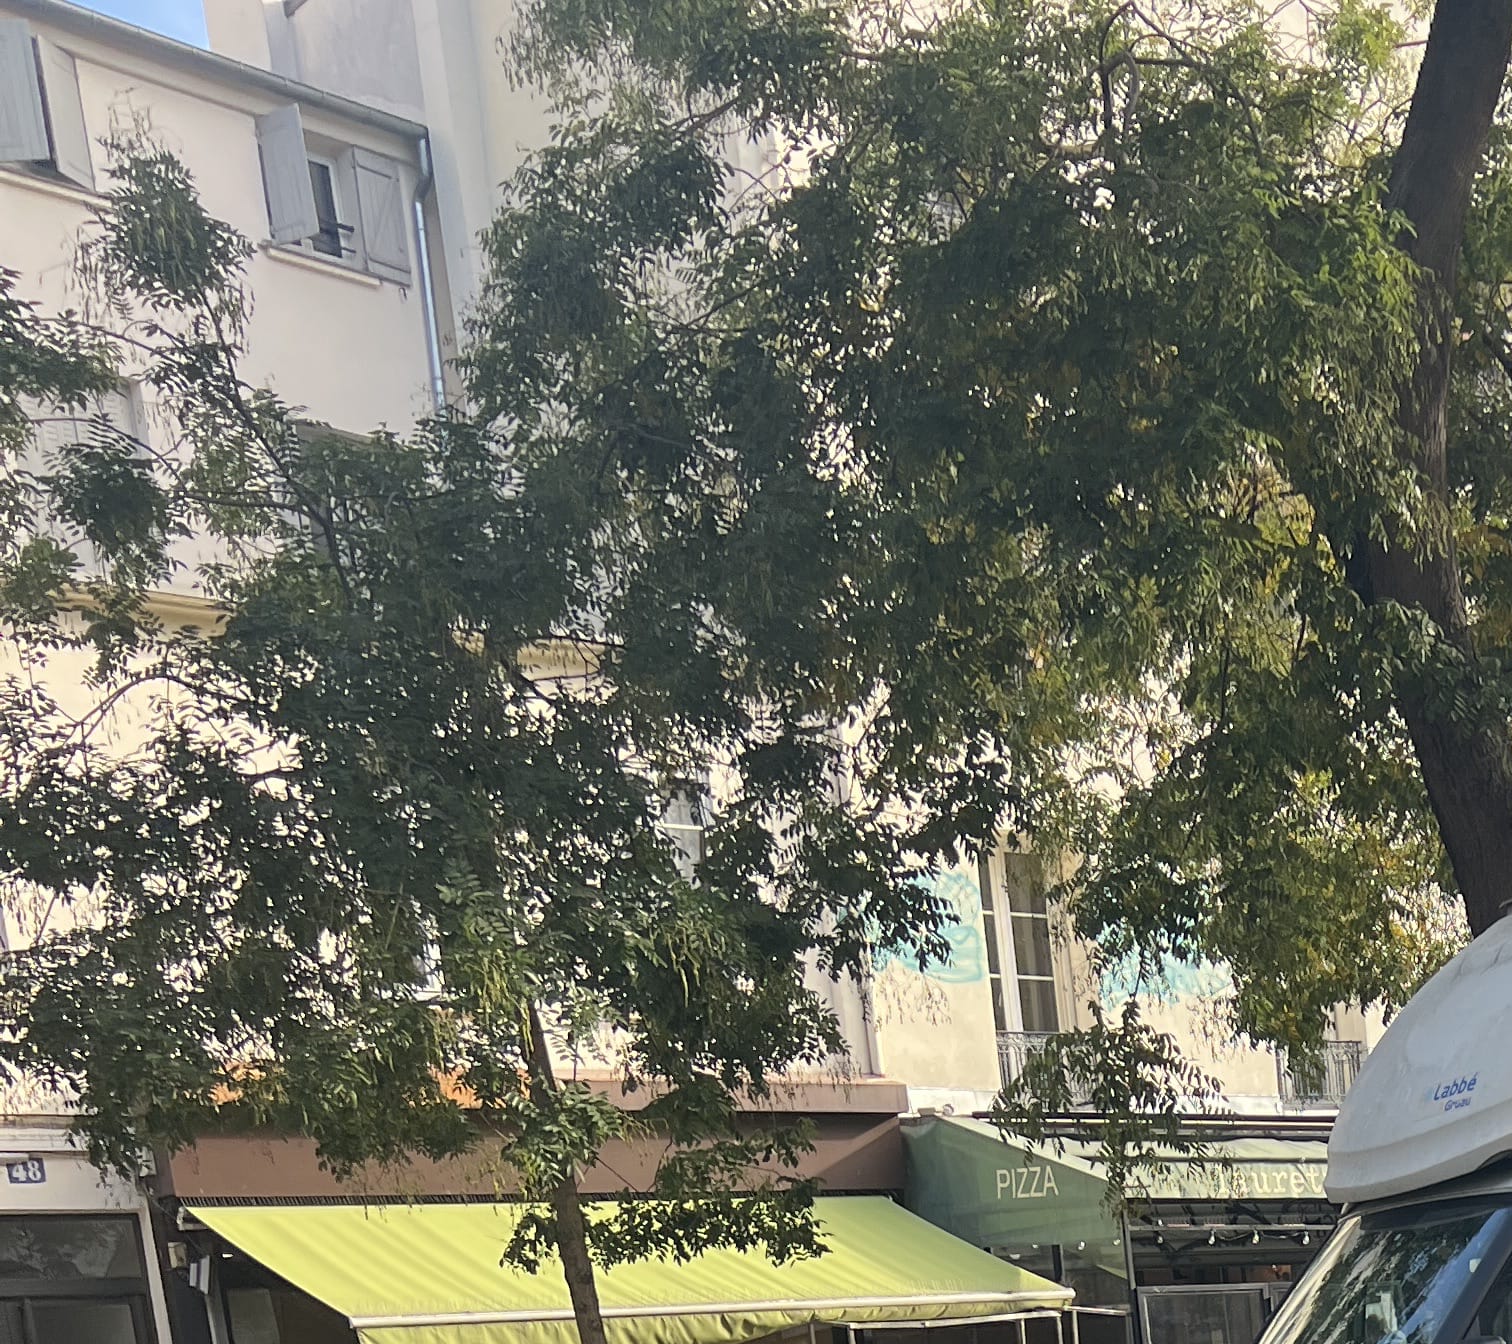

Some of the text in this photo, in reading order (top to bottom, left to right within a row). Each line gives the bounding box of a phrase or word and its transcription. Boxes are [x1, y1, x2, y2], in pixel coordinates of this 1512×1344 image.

[1433, 1072, 1480, 1101] Labbé
[12, 1160, 41, 1181] 48
[996, 1165, 1059, 1199] PIZZA
[1217, 1164, 1328, 1195] lauret
